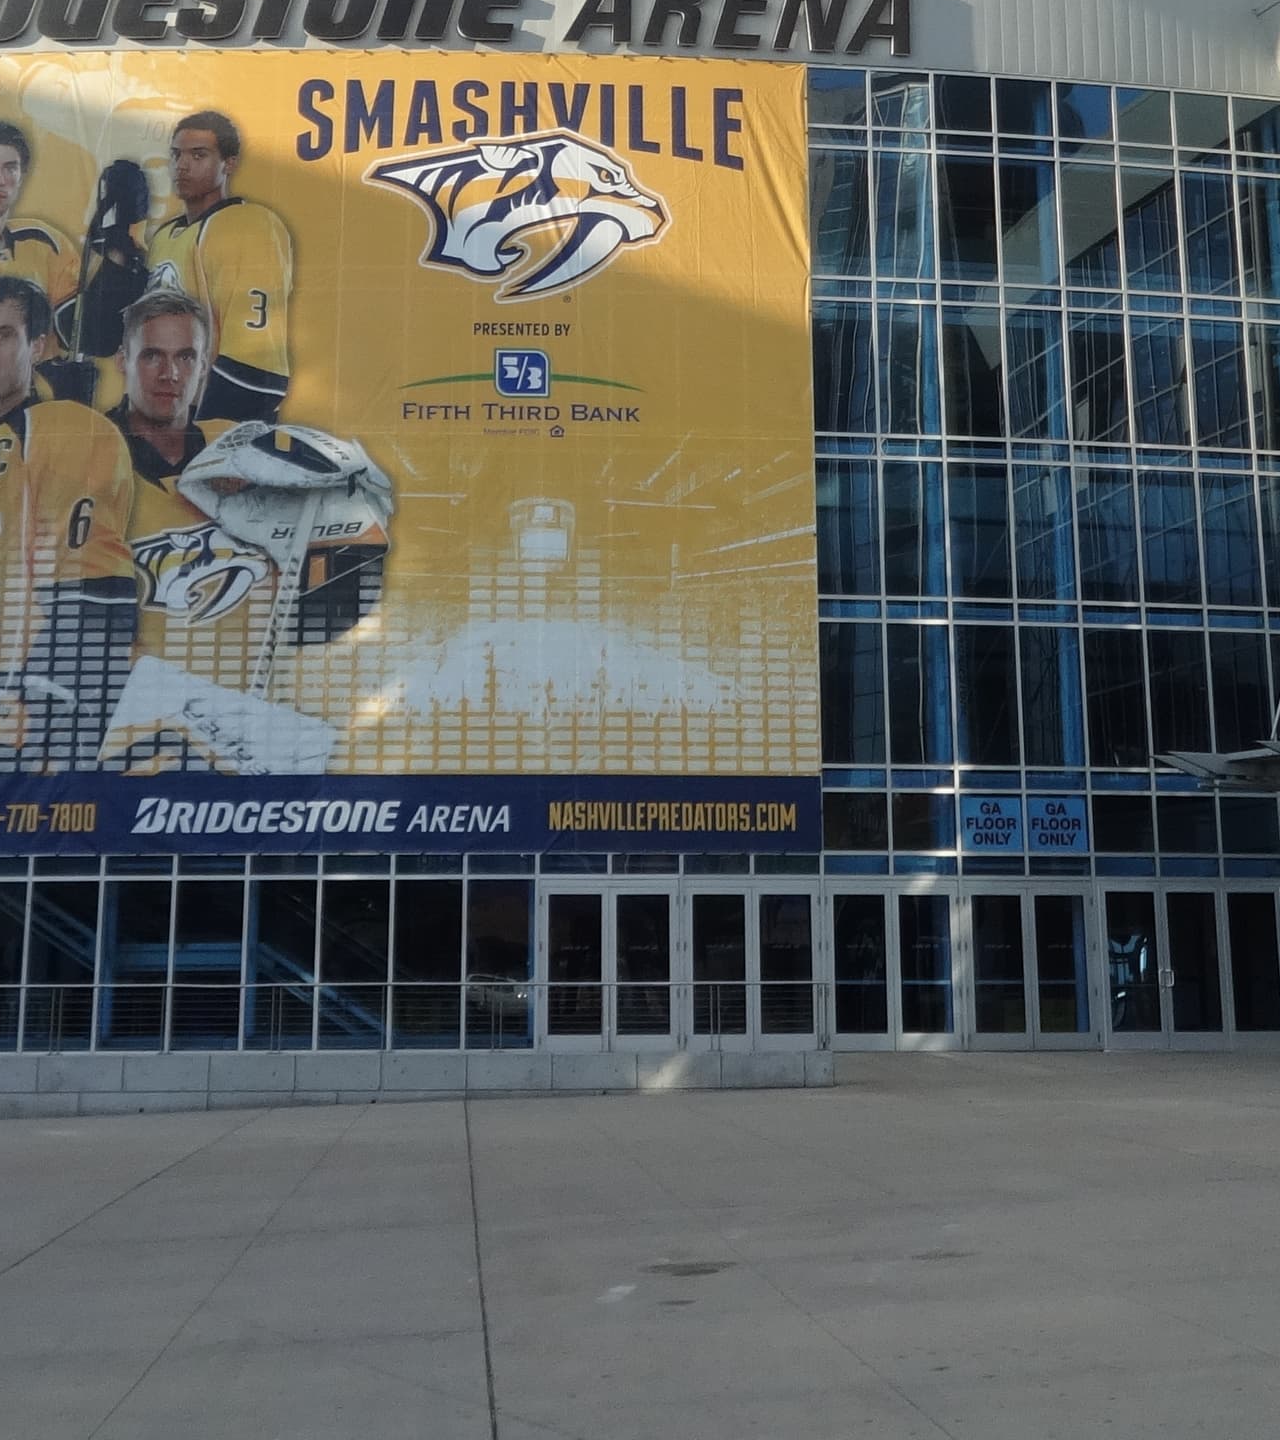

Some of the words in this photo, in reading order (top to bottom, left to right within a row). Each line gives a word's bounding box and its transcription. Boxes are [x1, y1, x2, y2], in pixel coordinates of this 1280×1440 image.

[296, 78, 745, 172] SMASHVILLE
[245, 288, 269, 331] 3
[472, 321, 551, 338] PRESENTED
[554, 321, 571, 338] BY
[401, 402, 472, 423] FIFTH
[481, 402, 561, 423] THIRD
[571, 404, 640, 424] BANK
[67, 496, 96, 550] 6
[130, 797, 401, 834] BRIDGESTONE
[406, 804, 511, 833] ARENA
[548, 800, 797, 832] NASHVILLEPREDATORS.COM
[979, 801, 1002, 816] GA
[1044, 802, 1067, 816] GA
[966, 816, 1017, 831] FLOOR
[1031, 817, 1081, 831] FLOOR
[972, 832, 1012, 846] ONLY
[1038, 832, 1077, 847] ONLY
